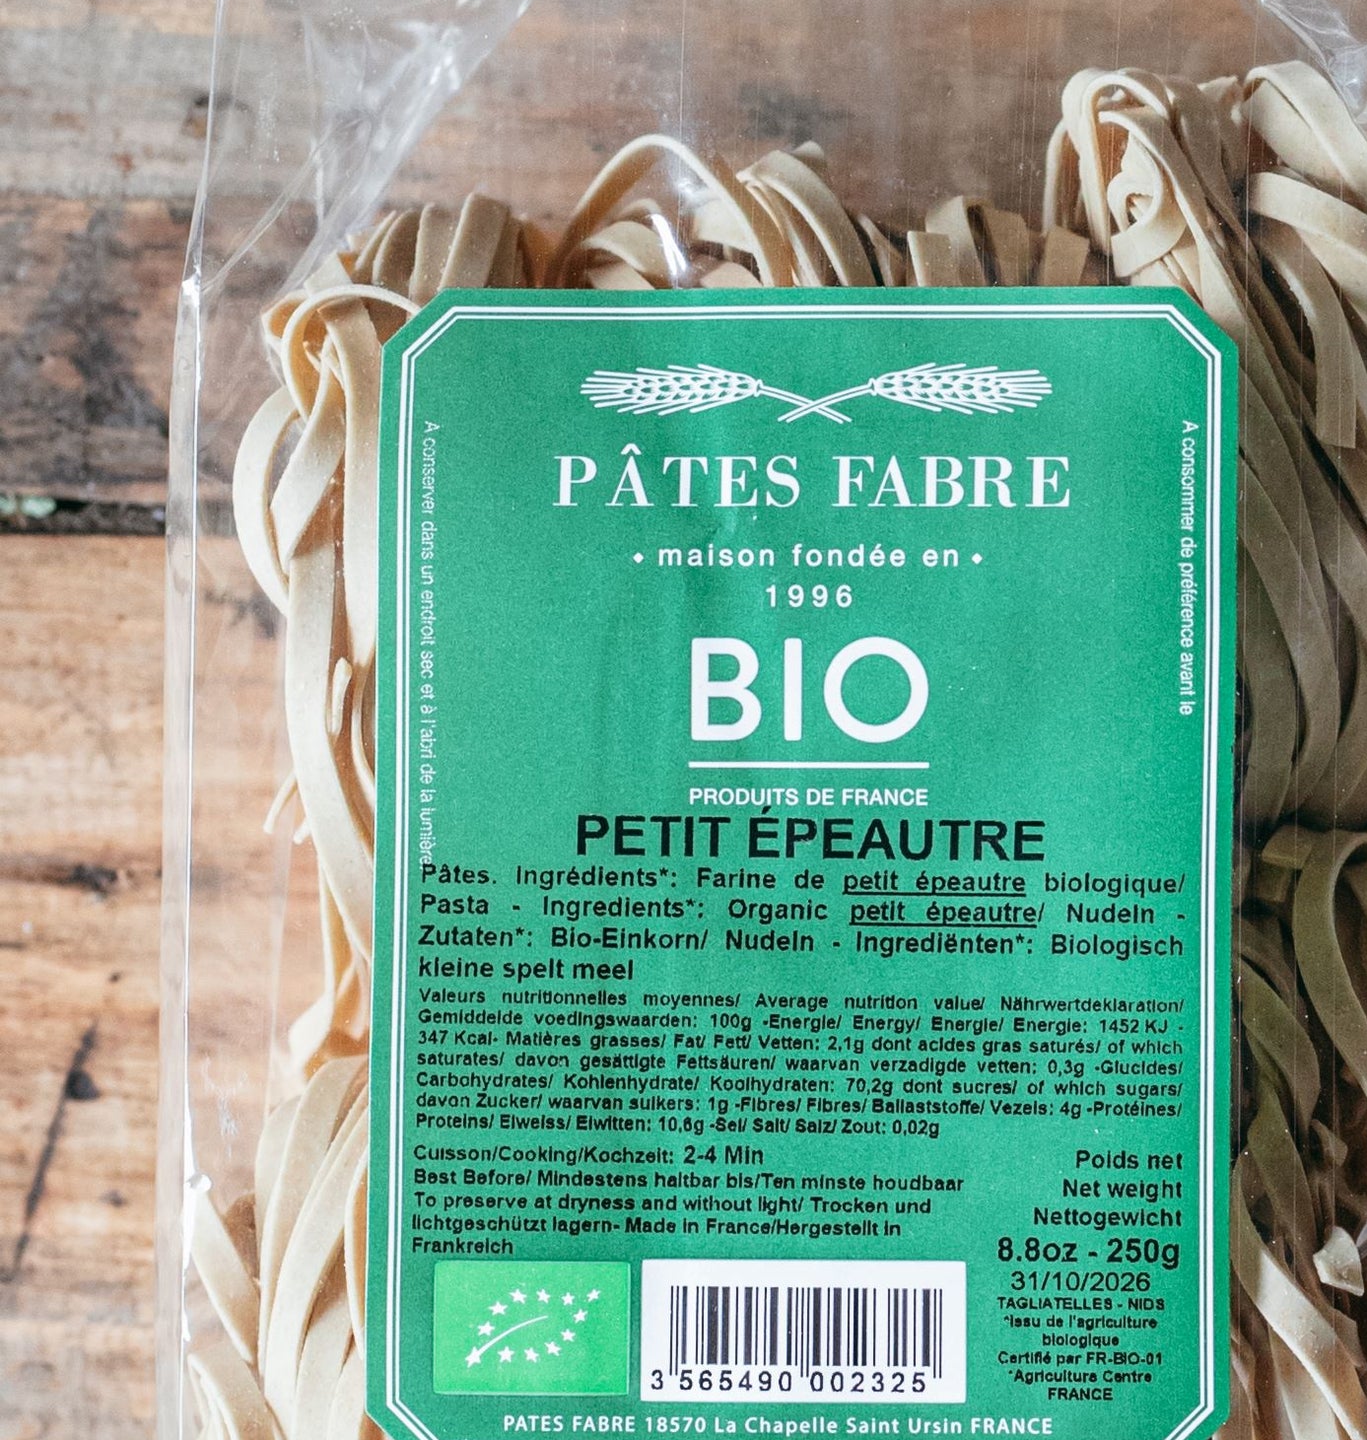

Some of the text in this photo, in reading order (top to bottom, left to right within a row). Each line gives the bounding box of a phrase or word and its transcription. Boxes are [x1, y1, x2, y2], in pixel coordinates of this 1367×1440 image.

[553, 443, 1070, 508] PÂTES FABRE
[659, 543, 958, 567] maison fondée en
[1179, 420, 1198, 715] A consommer de préférence avant le
[766, 584, 852, 608] 1996
[420, 437, 437, 784] conserver dans endroit sec l'abri de
[691, 636, 929, 743] BIO
[690, 788, 928, 806] PRODUITS DE FRANCE
[577, 807, 1046, 861] PETIT ÉPEAUTRE
[422, 863, 496, 884] Pâtes.
[697, 867, 776, 889] Farine
[794, 869, 824, 889] de
[843, 872, 899, 895] petit
[916, 870, 1026, 894] épeautre
[1045, 872, 1185, 897] biologique/
[421, 894, 489, 915] Pasta
[728, 899, 828, 925] Organic
[850, 900, 906, 924] petit
[926, 900, 1045, 925] épeautre/
[1067, 903, 1155, 924] Nudeln
[551, 927, 708, 950] Bio-Einkorn/
[726, 929, 814, 952] Nudeln
[1052, 934, 1183, 960] Biologisch
[419, 956, 633, 983] kleine spelt meel
[419, 988, 485, 1003] Valeurs
[502, 990, 627, 1006] nutritionnelles
[643, 993, 741, 1010] moyennes/
[755, 993, 828, 1012] Average
[844, 995, 917, 1010] nutrition
[418, 1008, 1167, 1035] Gemiddelde voedingswaarden: 100g Energy/ Energie/ Energie: 1452 KJ
[418, 1030, 448, 1044] 347
[506, 1031, 581, 1047] Matières
[590, 1034, 666, 1051] grasses/
[758, 1035, 819, 1050] Vetten:
[828, 1036, 864, 1054] 2,1g
[872, 1036, 912, 1051] dont
[918, 1037, 975, 1052] acides
[982, 1041, 1021, 1056] gras
[1108, 1039, 1125, 1054] of
[1132, 1040, 1182, 1054] which
[417, 1052, 504, 1066] saturates/
[515, 1052, 569, 1067] davon
[677, 1054, 776, 1070] Fettsäuren/
[786, 1058, 859, 1071] waarvan
[870, 1057, 966, 1076] verzadigde
[977, 1060, 1036, 1074] vetten:
[1048, 1059, 1084, 1077] 0,3g
[417, 1072, 1183, 1098] Carbohydrates/ Kohlenhydrate/ Koolhydraten: 70,2g dont sucres/ of which sugars/
[416, 1092, 470, 1108] davon
[476, 1093, 542, 1109] Zucker/
[548, 1097, 623, 1110] waarvan
[629, 1096, 699, 1111] suikers:
[708, 1097, 728, 1115] 1g
[807, 1097, 867, 1113] Fibres/
[990, 1100, 1053, 1115] Vezels:
[1060, 1101, 1081, 1119] 4g
[416, 1113, 494, 1129] Proteins/
[841, 1119, 886, 1134] Zout:
[892, 1119, 939, 1138] 0,02g
[413, 1144, 763, 1166] Cuisson/Cooking/Kochzeit: 2-4 Min
[1076, 1150, 1183, 1170] Poids net
[414, 1168, 964, 1191] Best Before/ Mindestens haltbar minste houdbaar
[1063, 1179, 1182, 1203] Net weight
[414, 1191, 931, 1214] To preserve at dryness and without Trocken und
[412, 1214, 900, 1236] lichtgeschützt Made in in
[1034, 1207, 1181, 1231] Nettogewicht
[412, 1237, 513, 1254] Frankreich
[998, 1237, 1179, 1270] 8.8oz 250g
[1011, 1271, 1150, 1292] 31/10/2026
[997, 1297, 1165, 1311] TAGLIATELLES NIDS
[1046, 1315, 1063, 1328] de
[1042, 1333, 1119, 1349] biologique
[1057, 1355, 1082, 1367] par
[1103, 1370, 1152, 1383] Centre
[1048, 1387, 1113, 1401] FRANCE
[504, 1415, 1052, 1437] PATES FABRE 18570 La Chapelle Saint Ursin FRANCE
